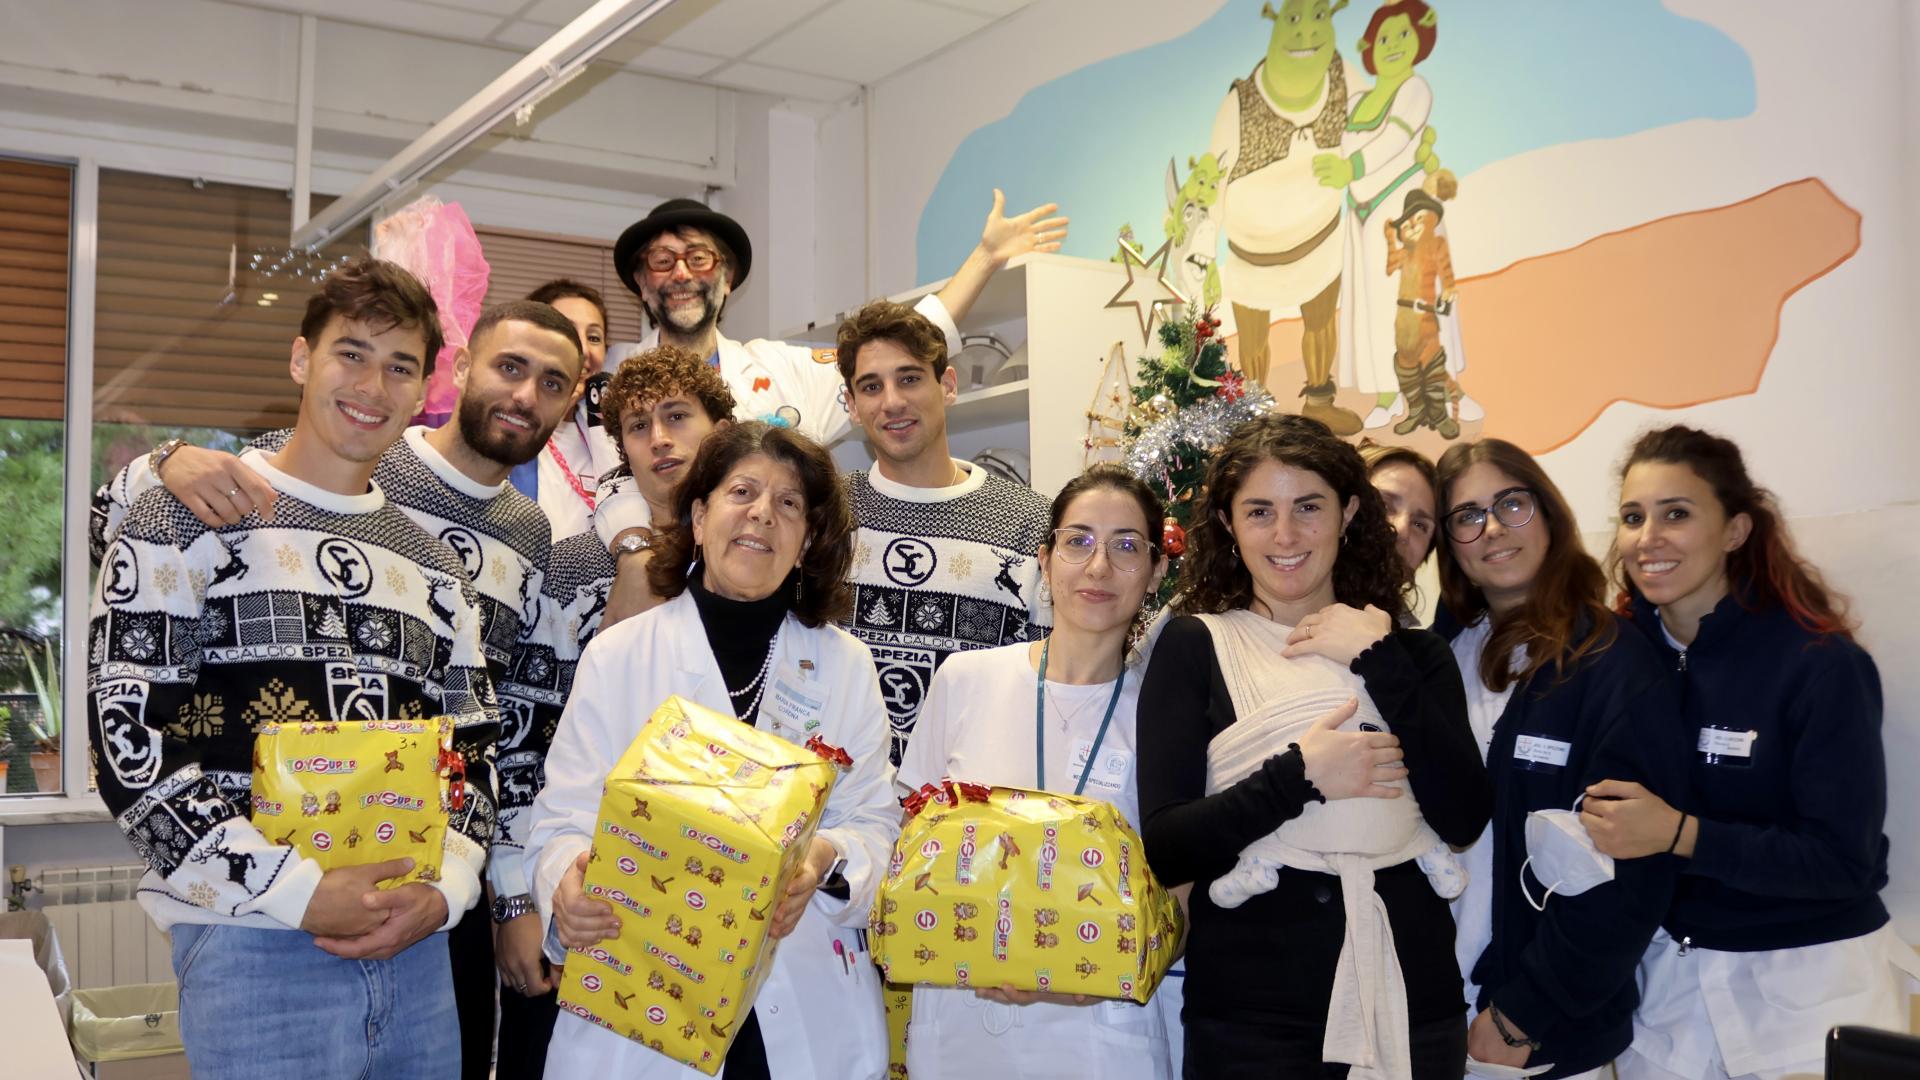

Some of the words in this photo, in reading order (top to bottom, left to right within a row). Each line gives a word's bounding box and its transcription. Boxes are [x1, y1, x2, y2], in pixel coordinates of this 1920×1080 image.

[225, 645, 297, 661] CALCIO
[302, 646, 350, 658] SPEZI
[850, 629, 900, 643] SPEZIA
[903, 635, 955, 649] CALCIO
[870, 647, 932, 664] SPEZIA
[107, 664, 171, 680] CALCIO
[509, 684, 556, 701] CALCIO
[286, 757, 357, 775] TOYSUPER
[124, 795, 158, 824] SPEZIA
[360, 792, 425, 809] TOYSUPER
[603, 822, 668, 859] TOYSUPER
[681, 825, 749, 861] TOYSUPER
[1041, 821, 1058, 891] TOYSUPER
[586, 885, 651, 916] TOYSUPER
[996, 893, 1011, 961] TOYSUPER
[574, 947, 632, 975] OYSUPER
[644, 941, 705, 984] TOYSUPER
[559, 1000, 613, 1029] OYSUPER
